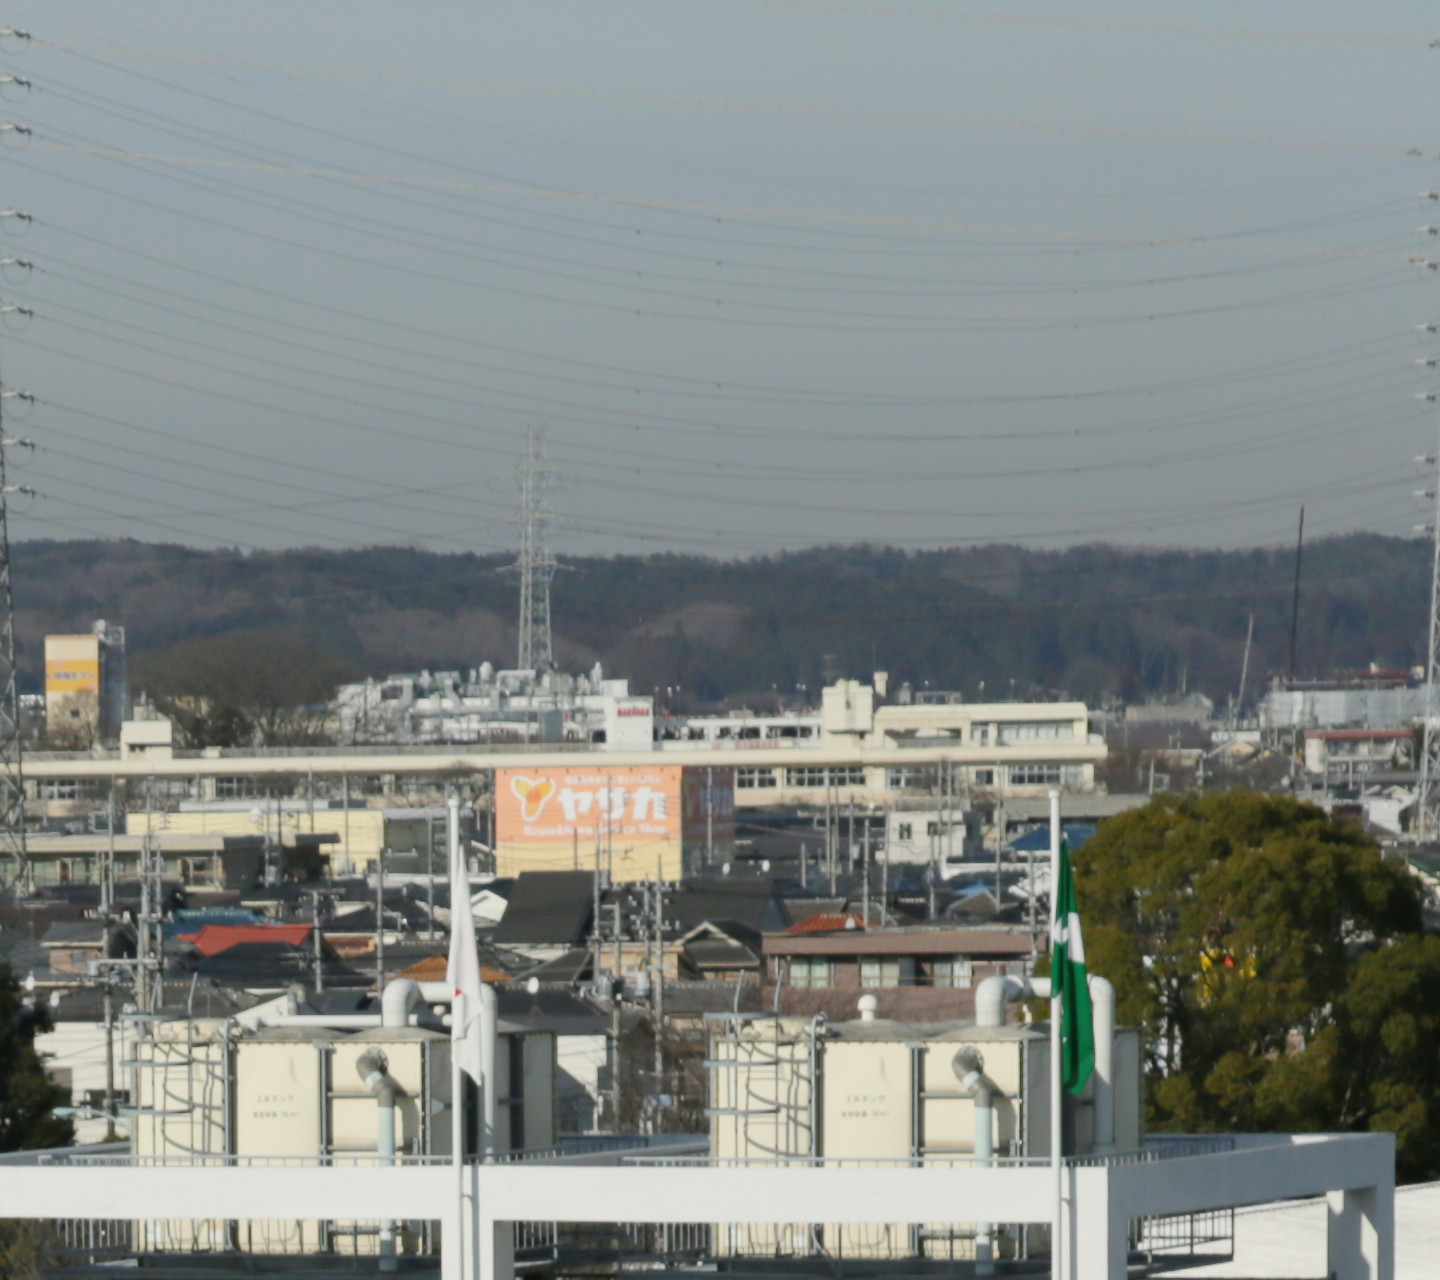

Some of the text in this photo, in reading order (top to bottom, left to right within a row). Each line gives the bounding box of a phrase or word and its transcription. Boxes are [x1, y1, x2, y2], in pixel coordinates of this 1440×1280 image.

[558, 786, 668, 820] ヤサカ
[524, 824, 593, 836] House&Hme
[598, 823, 637, 834] Sevice
